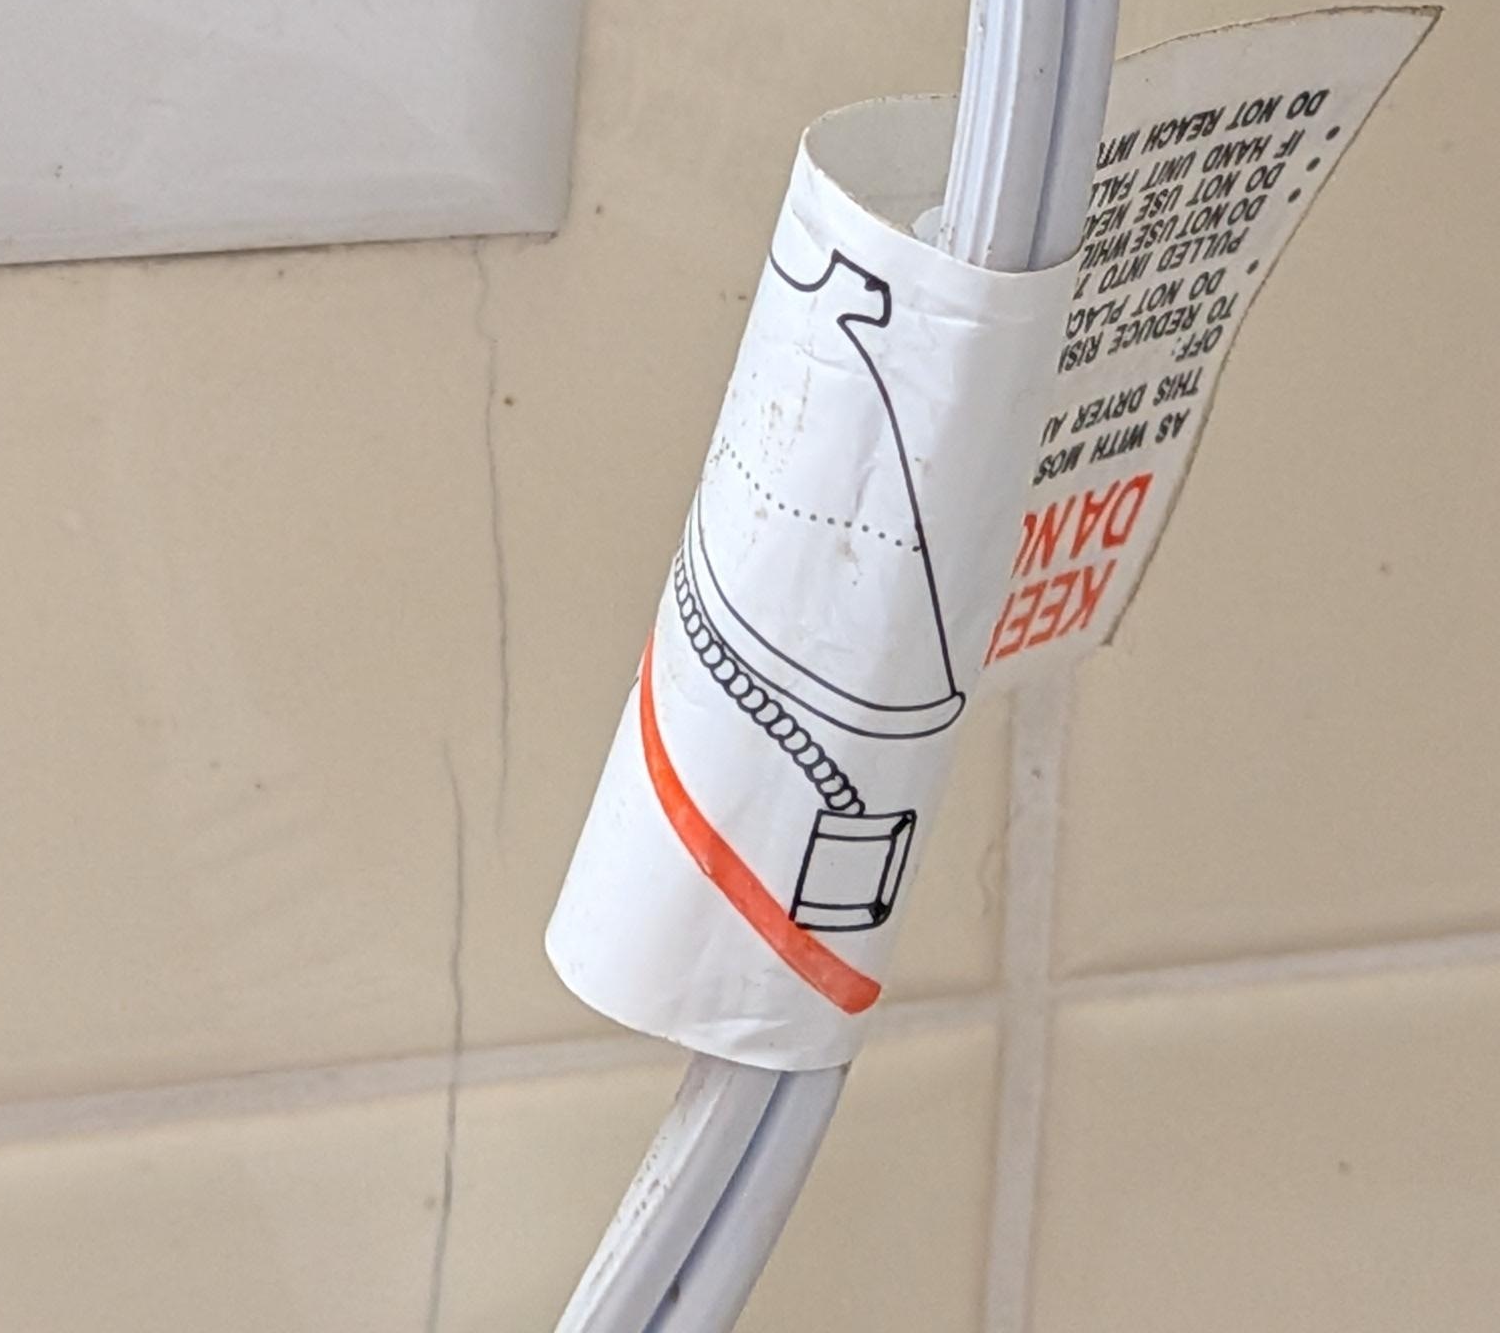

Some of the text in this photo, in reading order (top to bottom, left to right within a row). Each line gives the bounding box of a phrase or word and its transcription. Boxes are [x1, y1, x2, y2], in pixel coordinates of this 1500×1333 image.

[1225, 94, 1283, 131] NOT
[1286, 89, 1330, 119] DO
[1141, 106, 1226, 155] REACH
[1273, 128, 1306, 159] IF
[1138, 150, 1197, 193] UNIT
[1202, 134, 1272, 173] HAND
[1185, 170, 1241, 207] NOT
[1245, 161, 1286, 193] DO
[1133, 184, 1183, 224] USE
[1175, 202, 1229, 240] NOT
[1227, 194, 1268, 226] DO
[1130, 214, 1179, 254] USE
[1156, 226, 1249, 273] PULLED
[1097, 251, 1154, 295] INTO
[1189, 267, 1226, 301] DO
[1130, 278, 1184, 317] NOT
[1207, 292, 1239, 325] TO
[1107, 302, 1202, 355] REDUCE
[1171, 324, 1223, 363] OFF:
[1153, 367, 1203, 406] THIS
[1071, 383, 1148, 434] DRYER
[1154, 408, 1190, 444] AS
[1089, 420, 1148, 464] WITH
